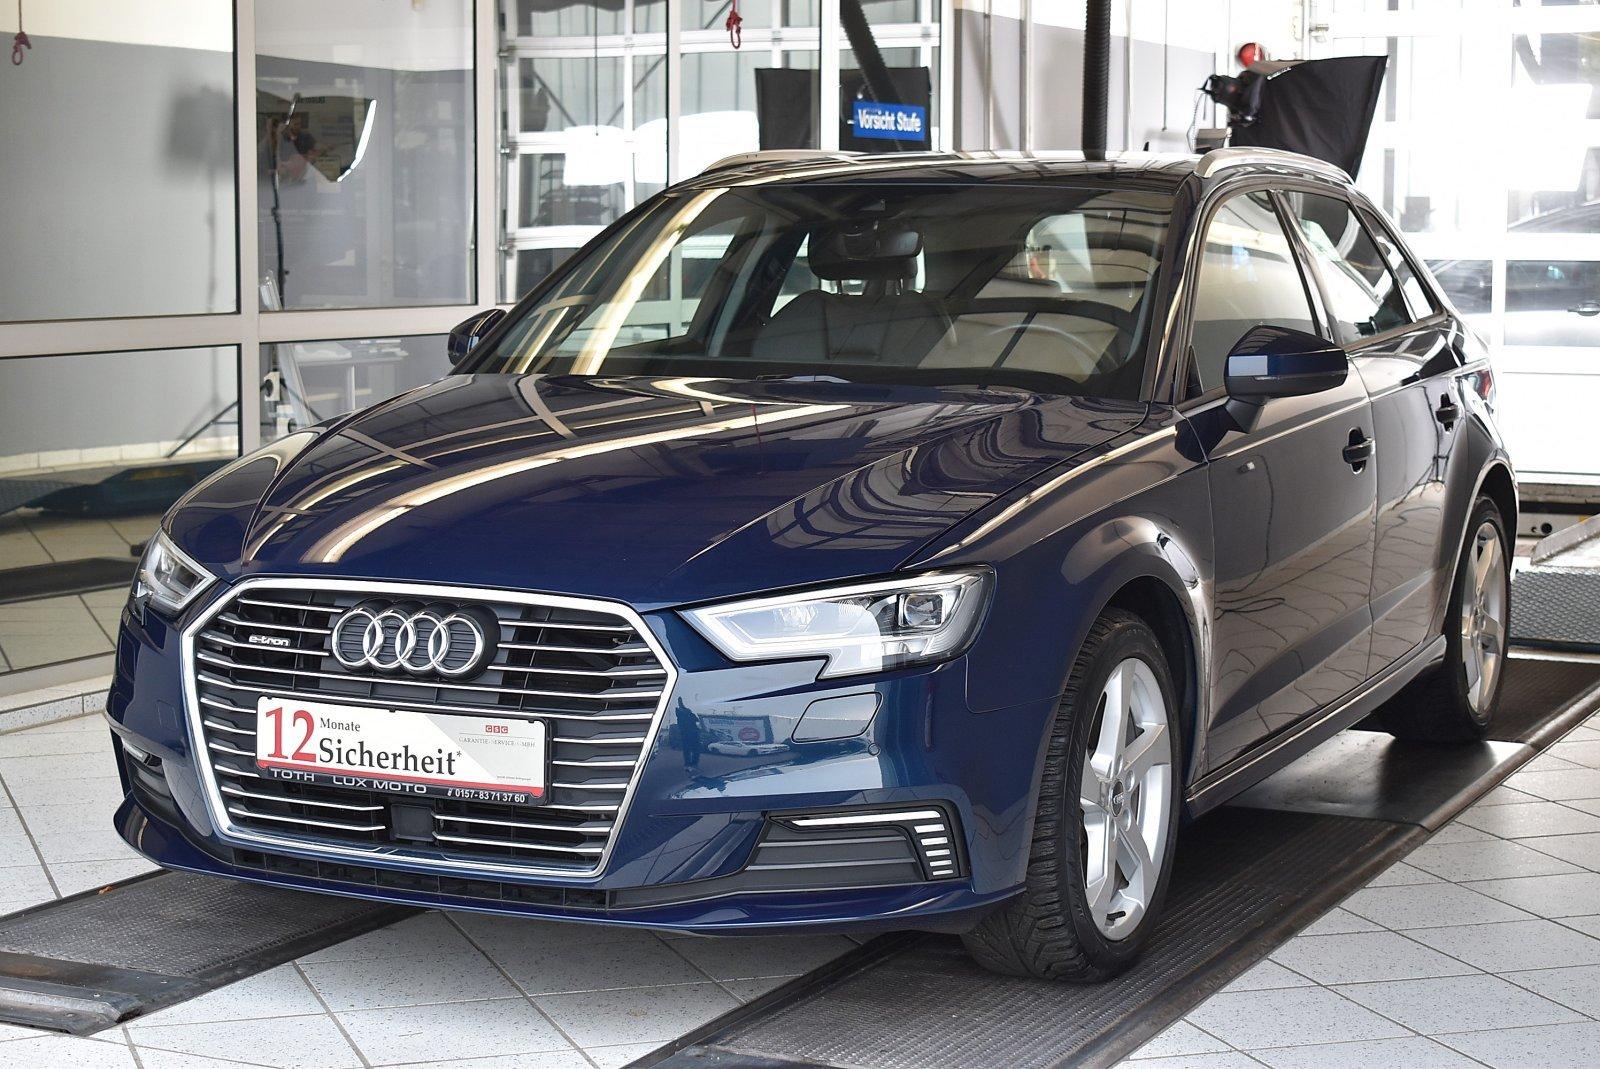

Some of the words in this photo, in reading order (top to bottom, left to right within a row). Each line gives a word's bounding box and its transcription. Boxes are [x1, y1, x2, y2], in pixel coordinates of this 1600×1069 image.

[858, 109, 896, 131] Vorsicht
[896, 111, 922, 132] Stufe
[248, 635, 290, 646] e-tron
[319, 717, 361, 732] Monate
[265, 706, 317, 763] 12
[270, 768, 315, 782] TOTH
[332, 775, 367, 788] LUX
[373, 780, 427, 794] MOTO
[491, 791, 500, 801] 71
[503, 792, 513, 802] 37
[514, 794, 525, 803] 60
